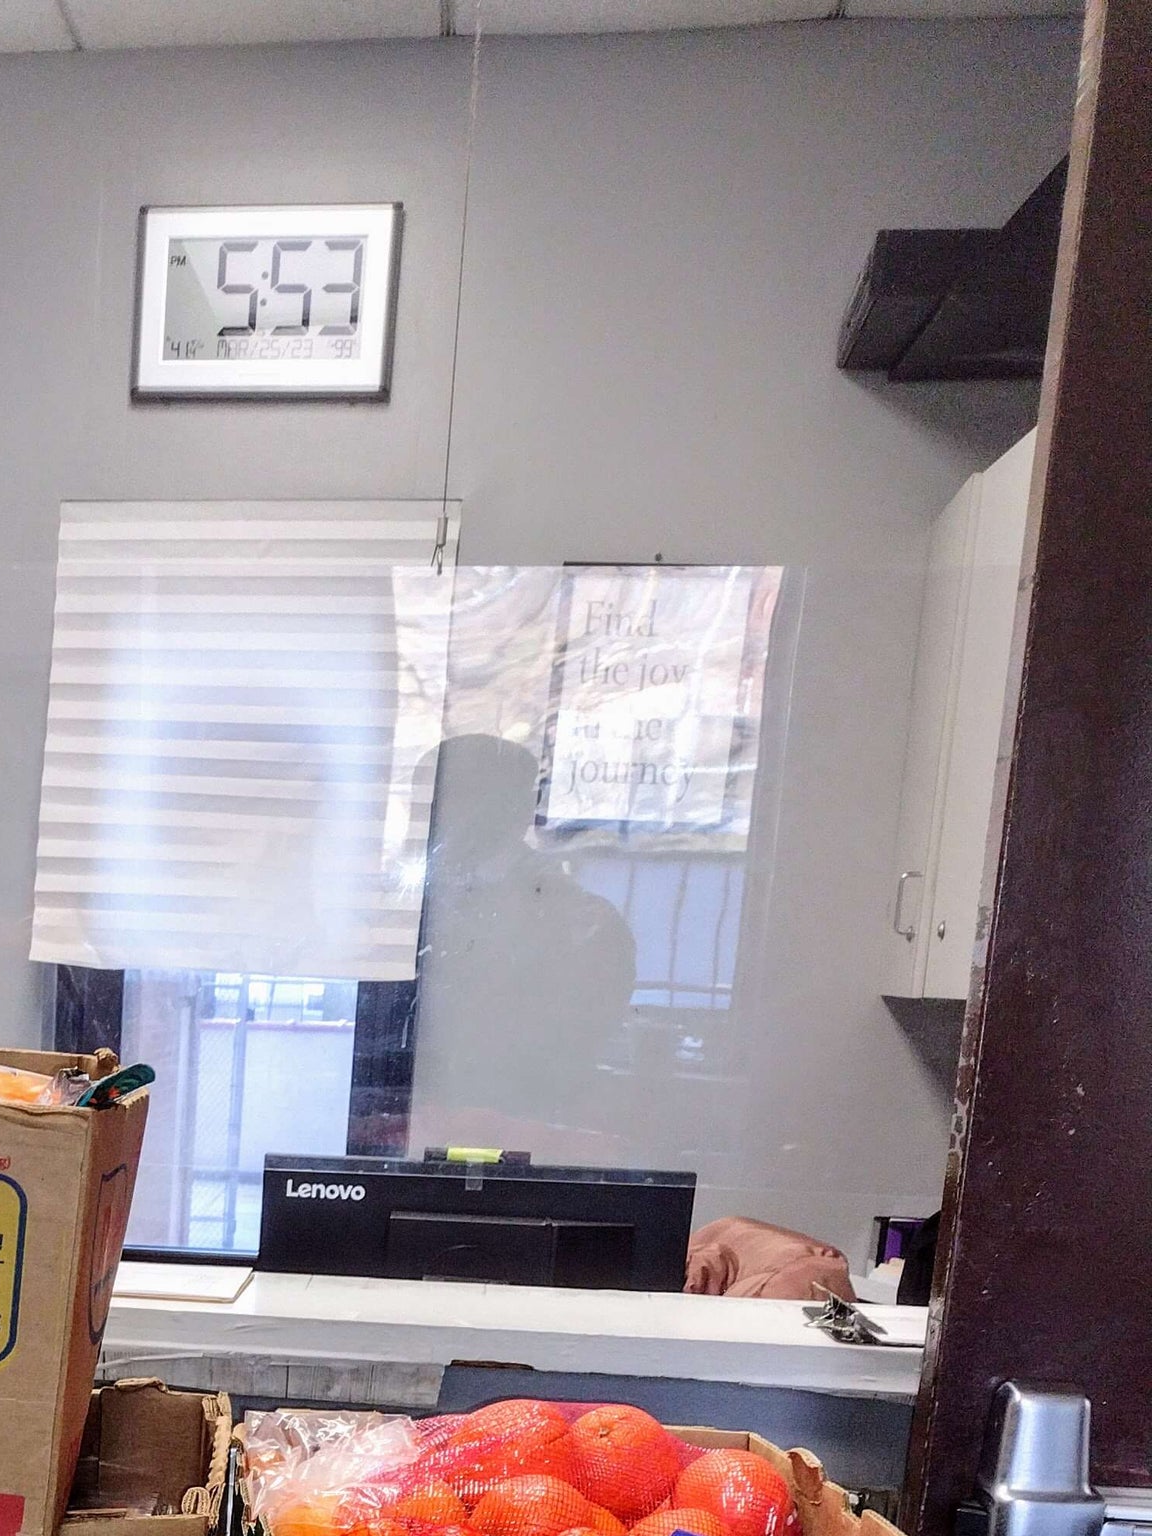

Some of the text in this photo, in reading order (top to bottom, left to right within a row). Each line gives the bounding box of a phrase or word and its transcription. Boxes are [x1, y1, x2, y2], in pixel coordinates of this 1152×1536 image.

[217, 240, 363, 336] 5:53
[582, 599, 659, 638] Find
[579, 647, 629, 684] the
[566, 756, 696, 801] journey
[285, 1178, 366, 1202] Lenovo
